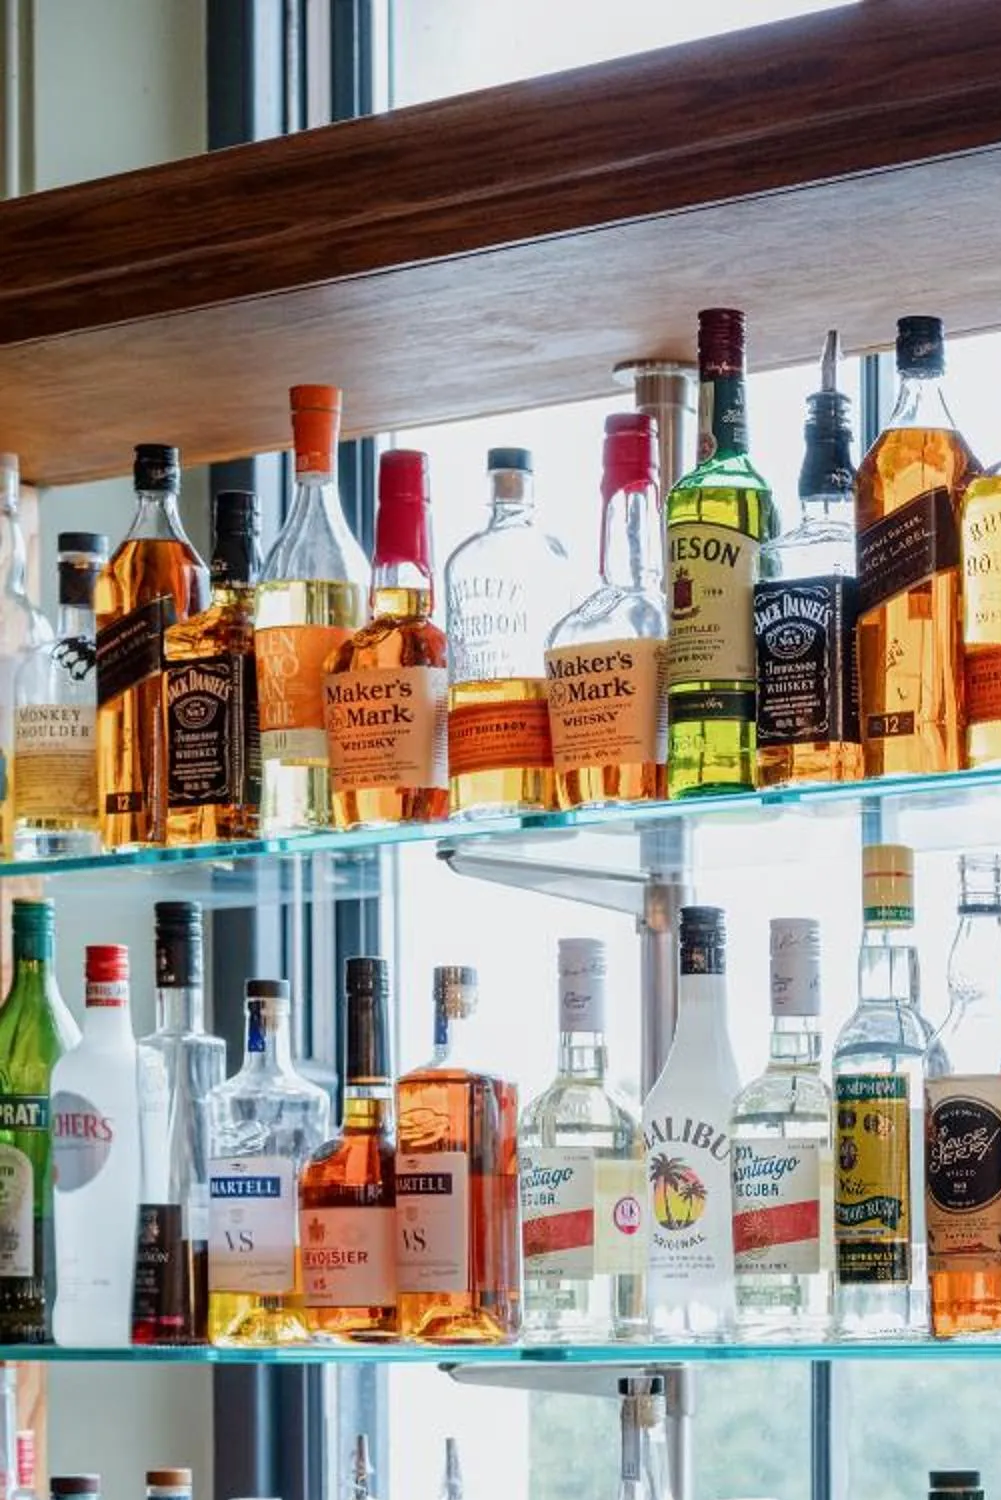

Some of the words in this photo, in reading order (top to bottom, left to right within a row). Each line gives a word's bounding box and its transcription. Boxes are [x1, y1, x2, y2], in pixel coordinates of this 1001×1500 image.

[670, 536, 741, 568] ESON
[754, 601, 782, 634] JACK
[783, 593, 833, 628] DANIEL'S
[547, 650, 634, 680] Maker's
[326, 679, 413, 705] Maker's
[567, 676, 635, 703] Mark
[765, 680, 816, 694] WHISKEY
[18, 709, 81, 722] MONKEY
[346, 703, 414, 729] Mark
[562, 710, 619, 727] WHISKY
[883, 716, 899, 733] 12
[340, 736, 396, 751] WHISKY
[117, 791, 130, 811] 12
[0, 1103, 40, 1126] PRAT
[211, 1179, 277, 1195] MARTELL
[396, 1176, 447, 1192] ARTELL
[745, 1183, 780, 1197] CUBA
[225, 1230, 255, 1253] VS
[402, 1227, 427, 1251] VS
[304, 1250, 369, 1265] VOISIER
